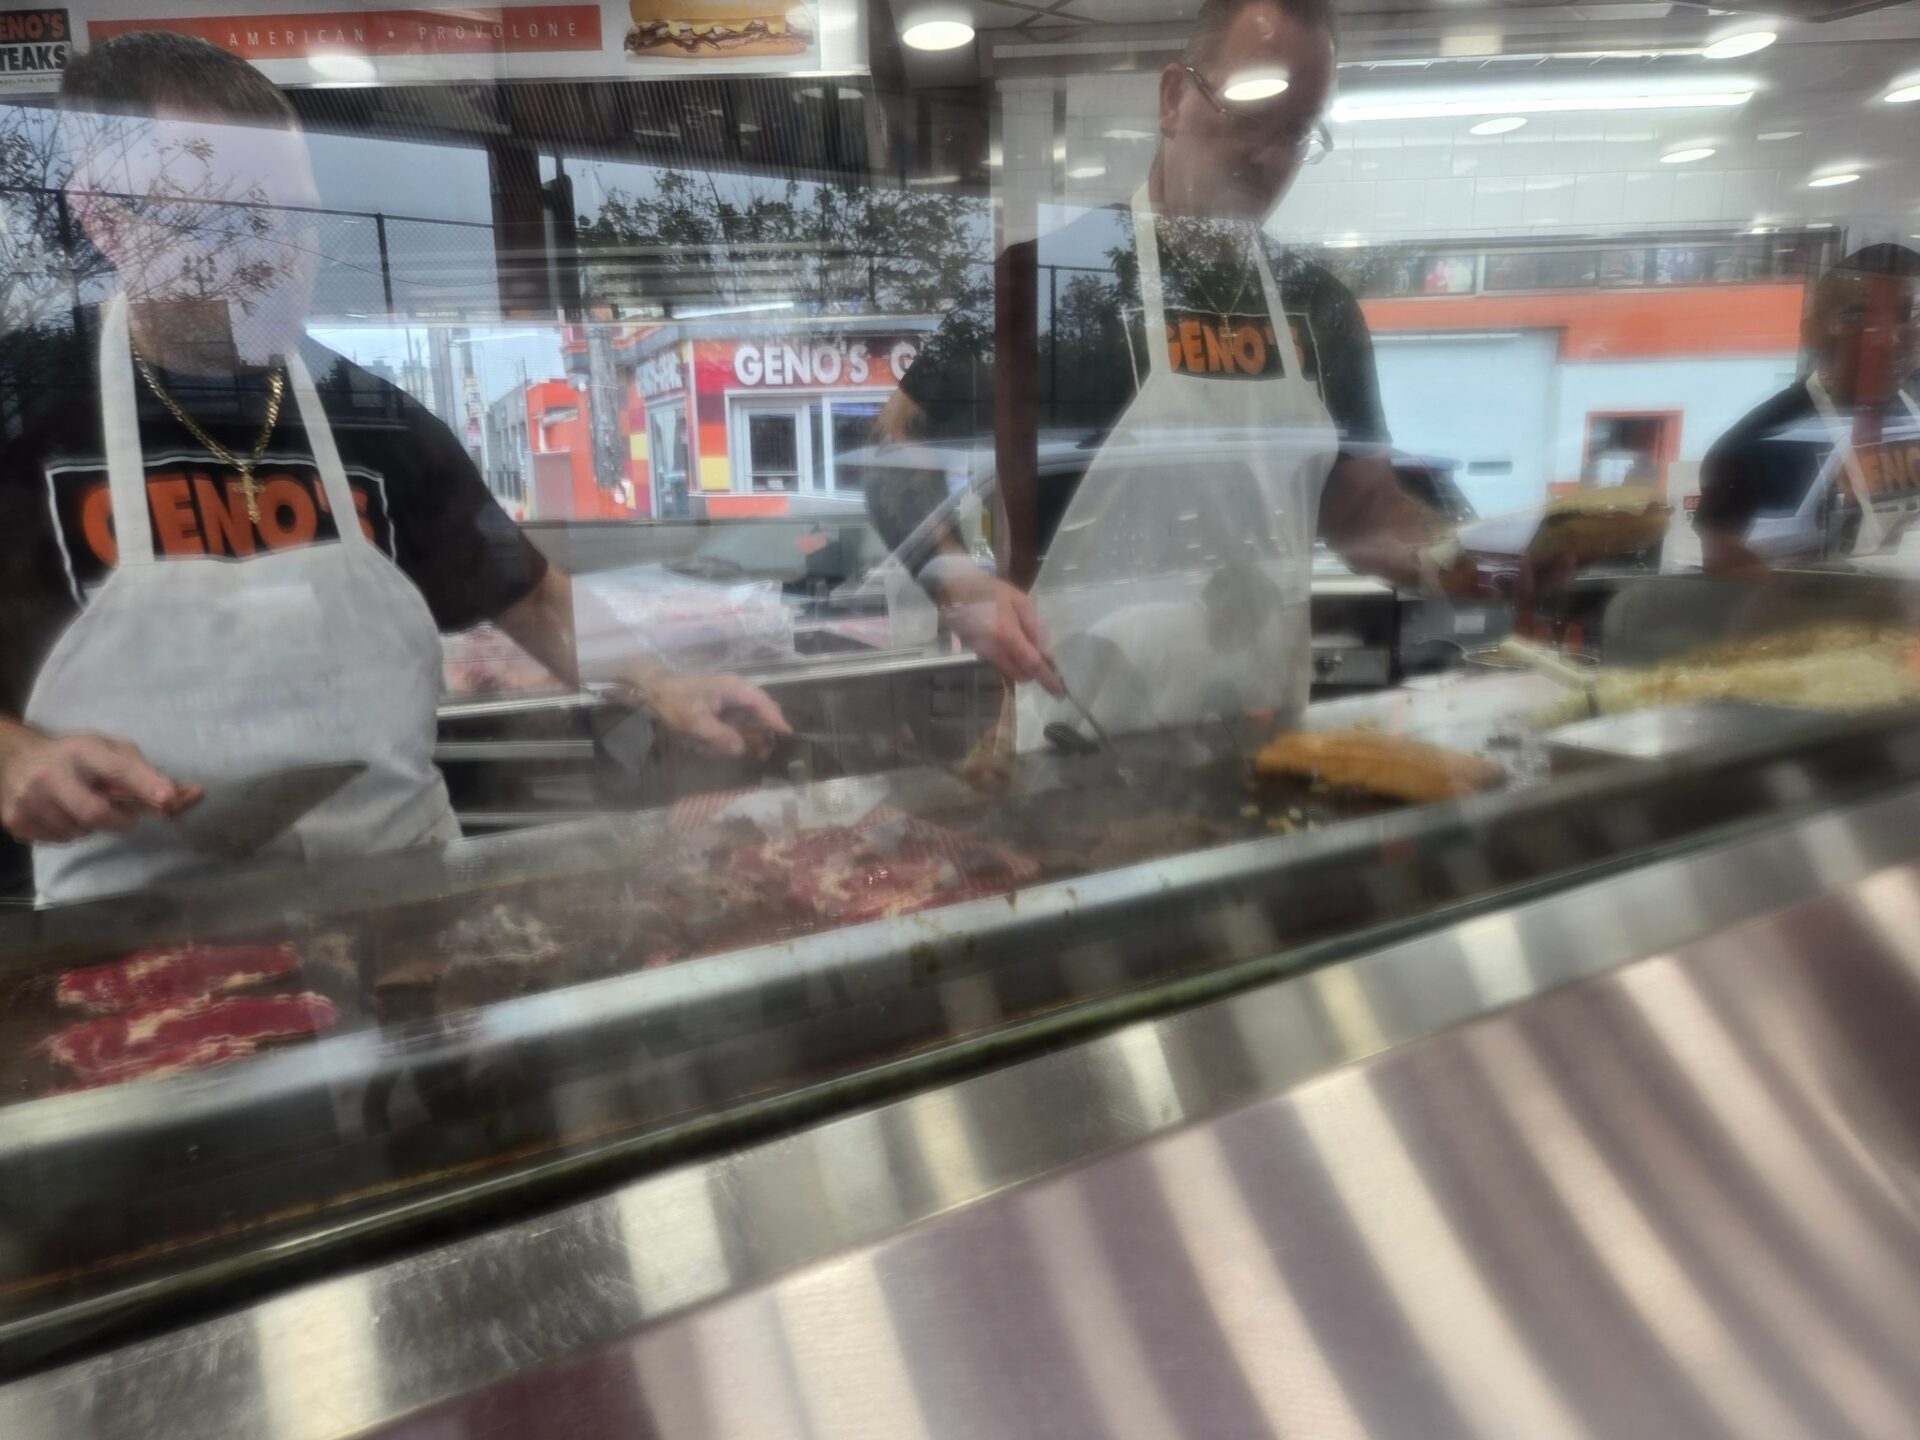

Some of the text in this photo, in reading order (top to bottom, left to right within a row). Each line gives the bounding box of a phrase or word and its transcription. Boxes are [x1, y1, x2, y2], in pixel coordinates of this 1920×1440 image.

[228, 22, 577, 47] AMERICAN PROVOLONE
[734, 340, 871, 386] GENO'S
[1165, 317, 1306, 376] ENO'
